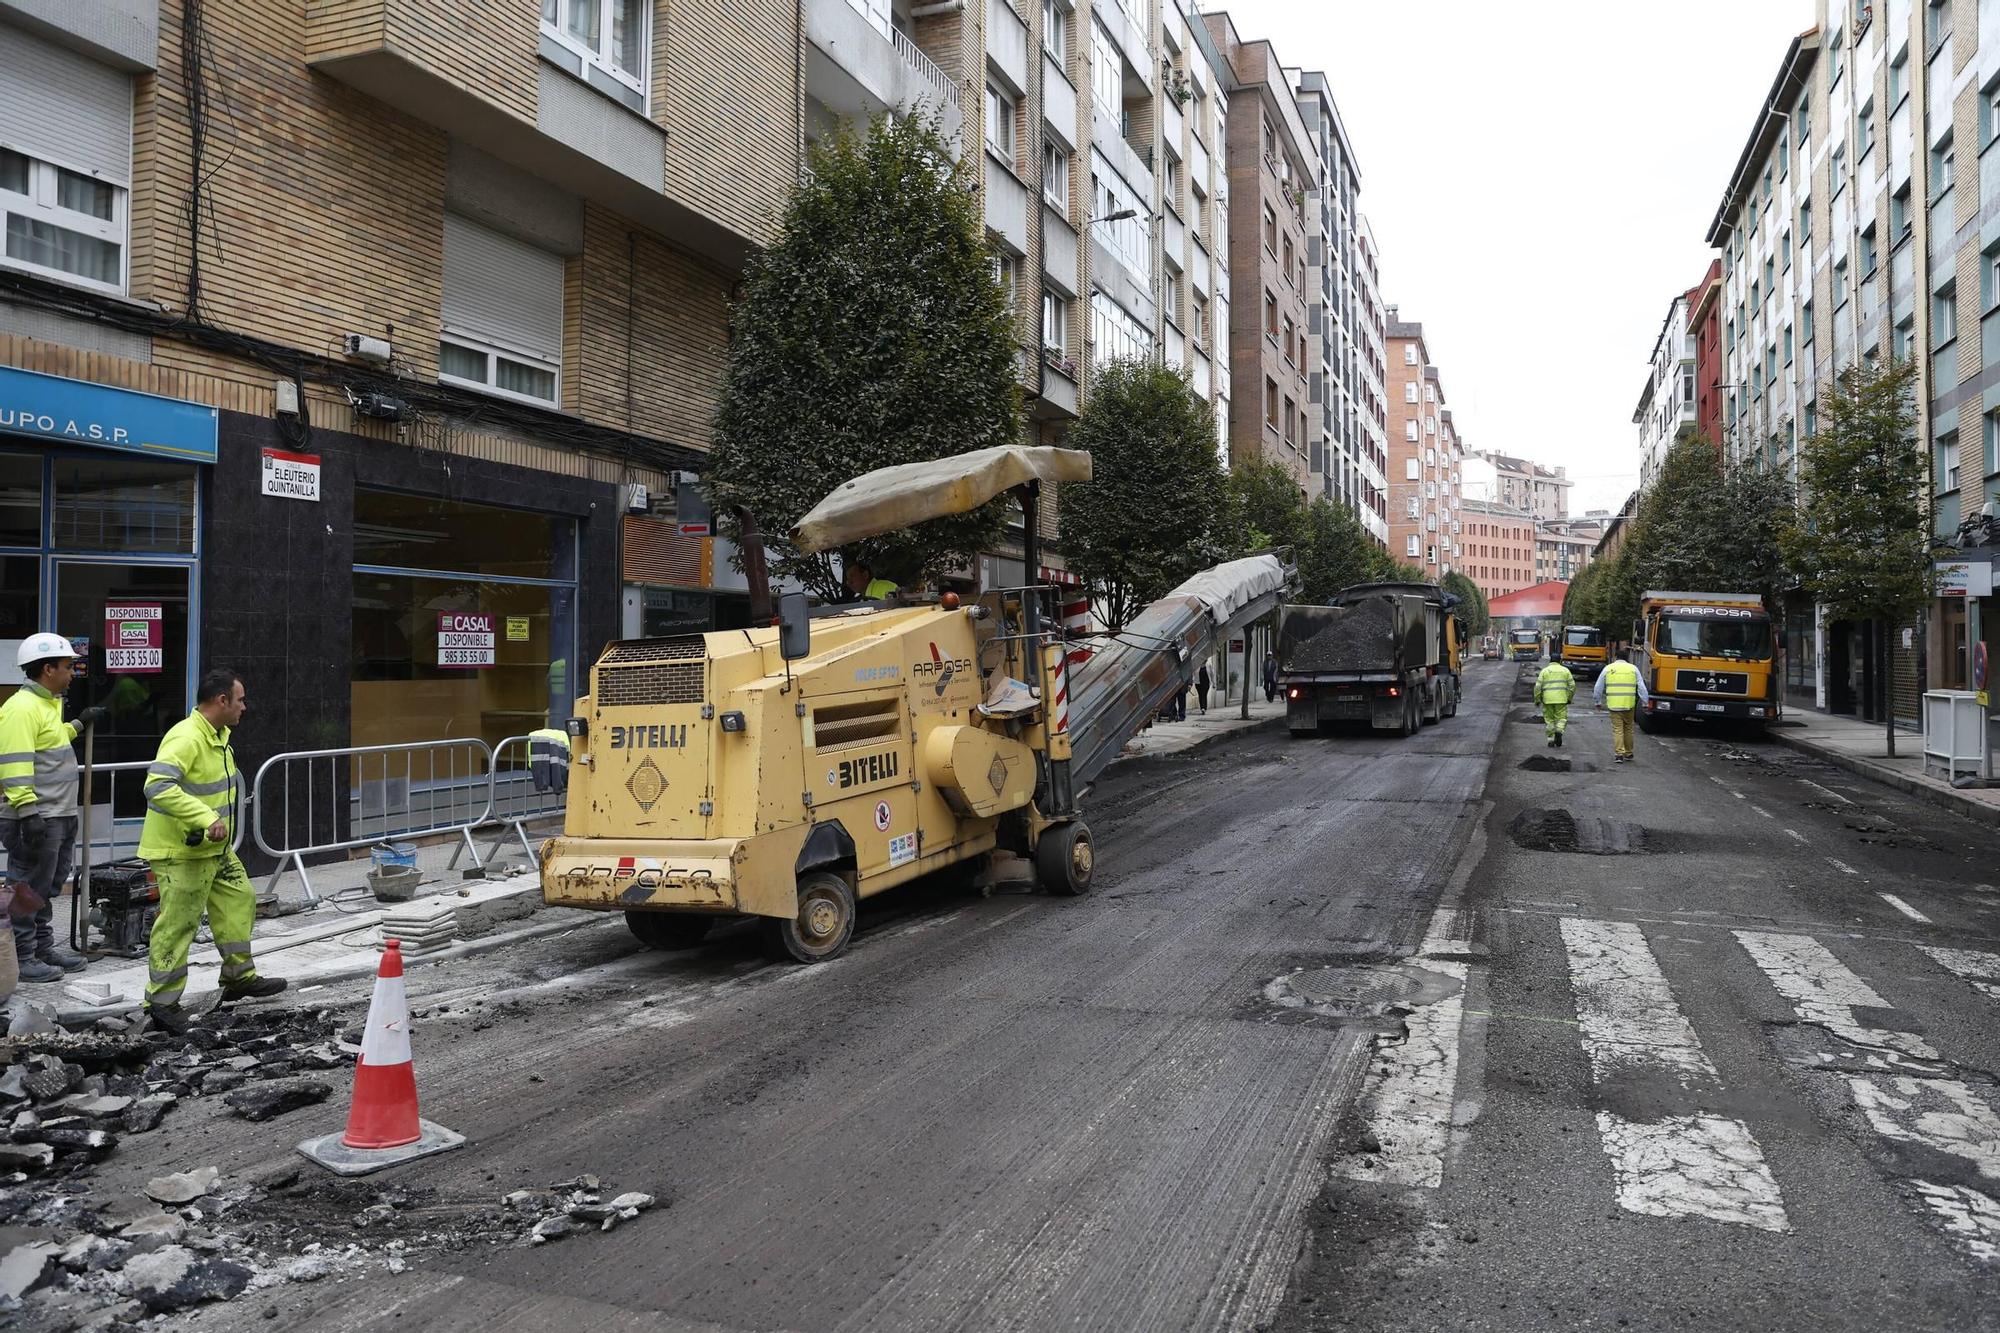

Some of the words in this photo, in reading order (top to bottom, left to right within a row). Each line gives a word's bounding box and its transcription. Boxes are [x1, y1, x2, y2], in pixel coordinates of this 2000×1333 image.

[64, 420, 129, 444] A.S.P.
[274, 468, 315, 484] ELEUTERIO
[267, 480, 315, 497] QUINTANILLA
[109, 608, 158, 618] DISPONIBLE
[1680, 607, 1752, 618] ARPOSA
[453, 616, 491, 632] CASAL
[444, 633, 488, 647] DISPONIBLE
[109, 650, 124, 666] 985
[126, 650, 136, 666] 35
[138, 650, 147, 666] 55
[149, 650, 160, 666] 00
[444, 650, 458, 663] 985
[459, 650, 469, 663] 35
[469, 650, 479, 663] 55
[479, 650, 488, 663] 00
[913, 658, 972, 678] ARPOSA
[1695, 677, 1728, 685] MAN
[610, 724, 687, 749] BITELLI
[839, 751, 898, 789] BITELLI
